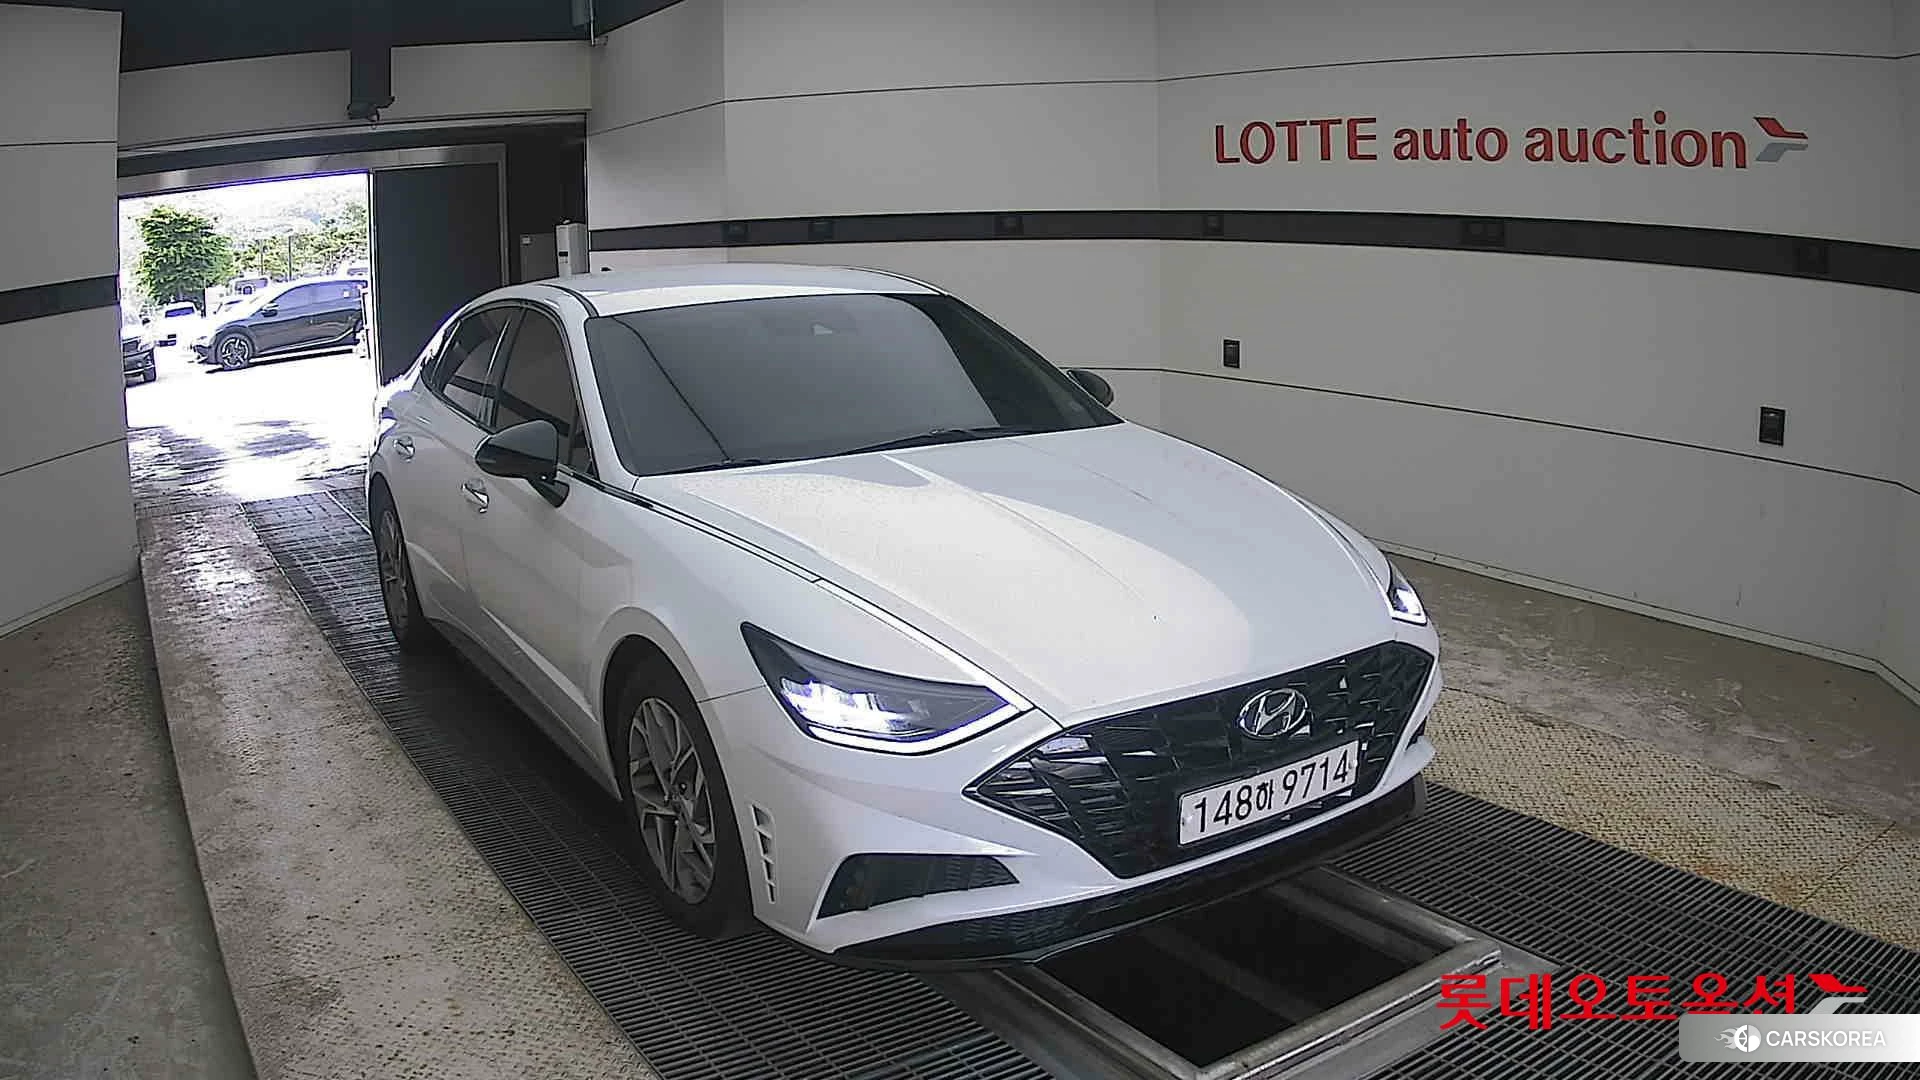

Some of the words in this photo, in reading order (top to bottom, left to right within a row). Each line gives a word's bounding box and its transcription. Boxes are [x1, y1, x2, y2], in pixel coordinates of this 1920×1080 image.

[1215, 117, 1378, 164] LOTTE
[1393, 118, 1509, 162] auto
[1524, 110, 1747, 168] auction
[1194, 778, 1275, 833] 148하
[1282, 749, 1350, 805] 9714
